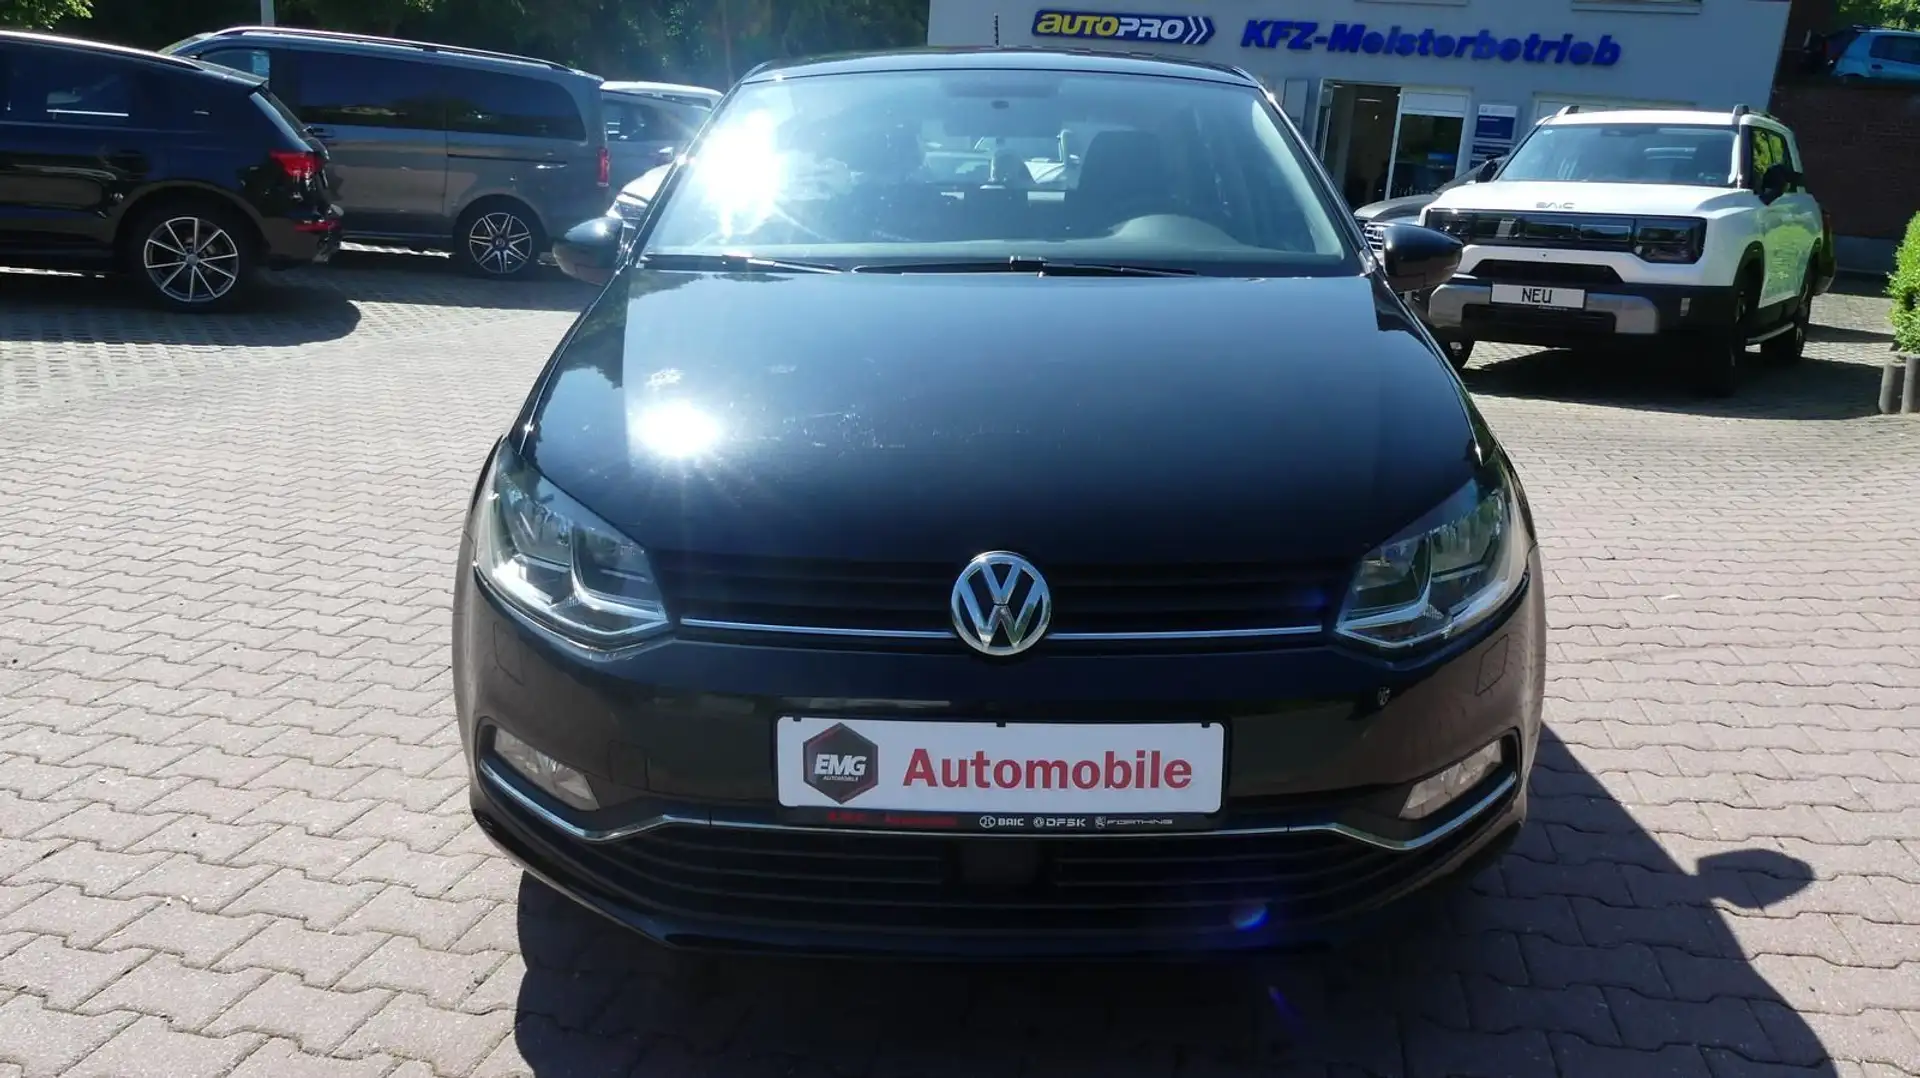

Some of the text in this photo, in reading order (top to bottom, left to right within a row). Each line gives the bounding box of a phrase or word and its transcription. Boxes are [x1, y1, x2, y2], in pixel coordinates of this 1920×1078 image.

[1240, 19, 1622, 67] KFZ-Meisterbetrieb
[1521, 287, 1553, 304] NEU
[814, 753, 867, 776] EMG
[903, 747, 1193, 790] Automobile
[998, 817, 1025, 827] BAIC
[1046, 817, 1086, 828] DFSK
